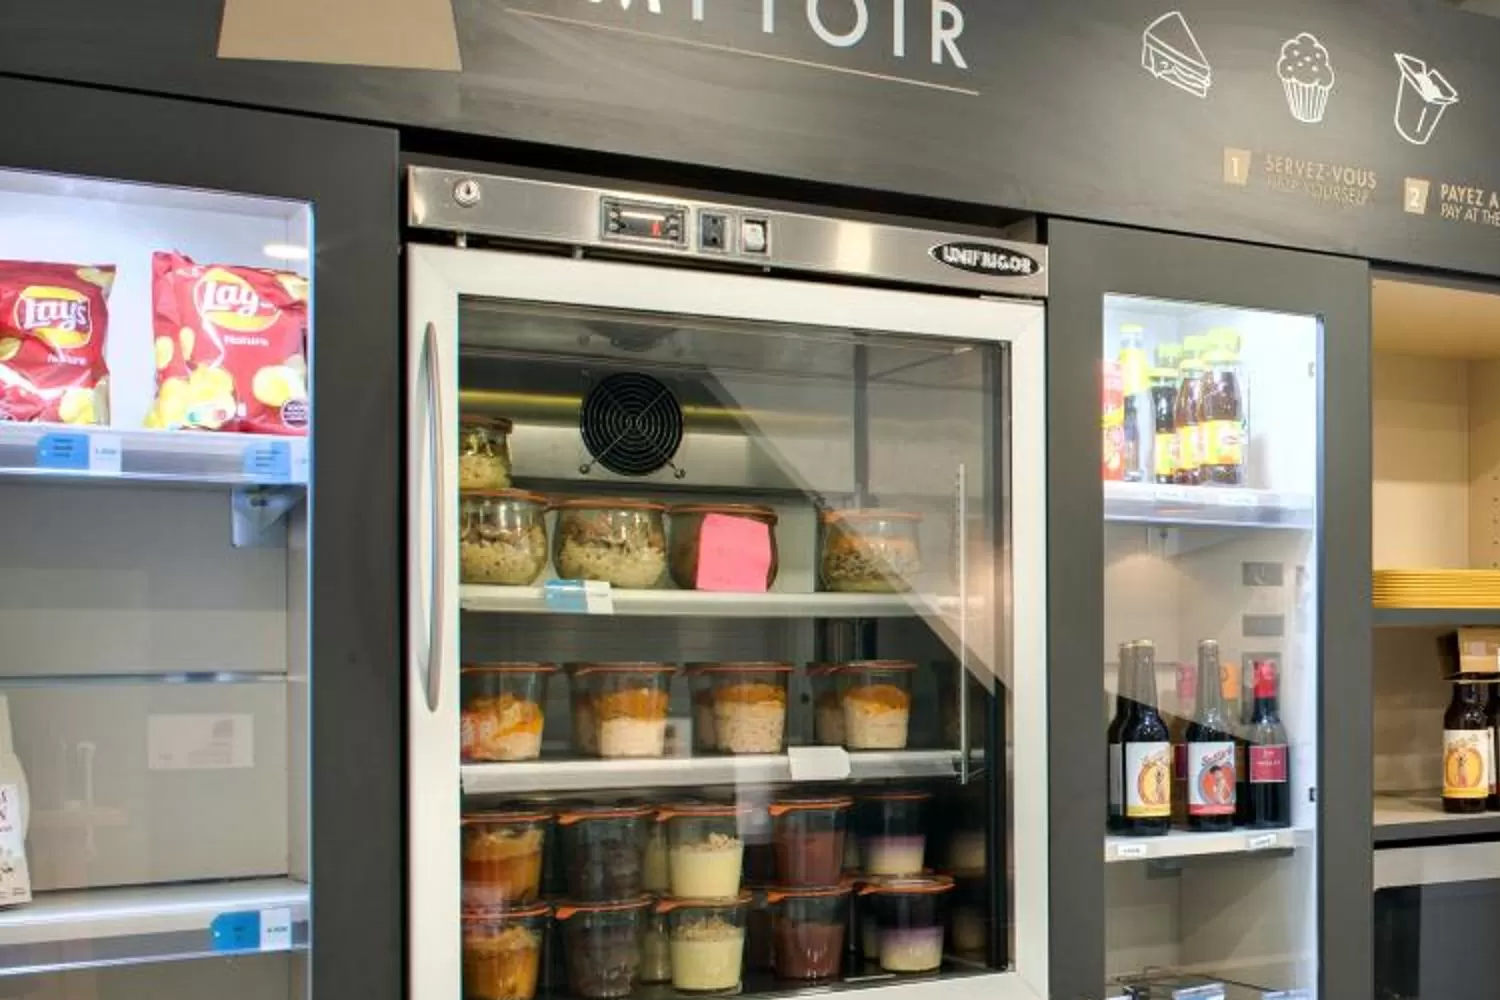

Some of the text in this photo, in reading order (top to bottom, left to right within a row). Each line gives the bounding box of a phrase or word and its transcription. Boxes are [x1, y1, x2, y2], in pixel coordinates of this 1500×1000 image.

[1440, 183, 1485, 208] PAYEZ
[1441, 202, 1463, 221] PAY
[1463, 206, 1481, 224] AT
[942, 245, 1032, 274] UNIFRIGOR
[23, 297, 88, 332] Lay's
